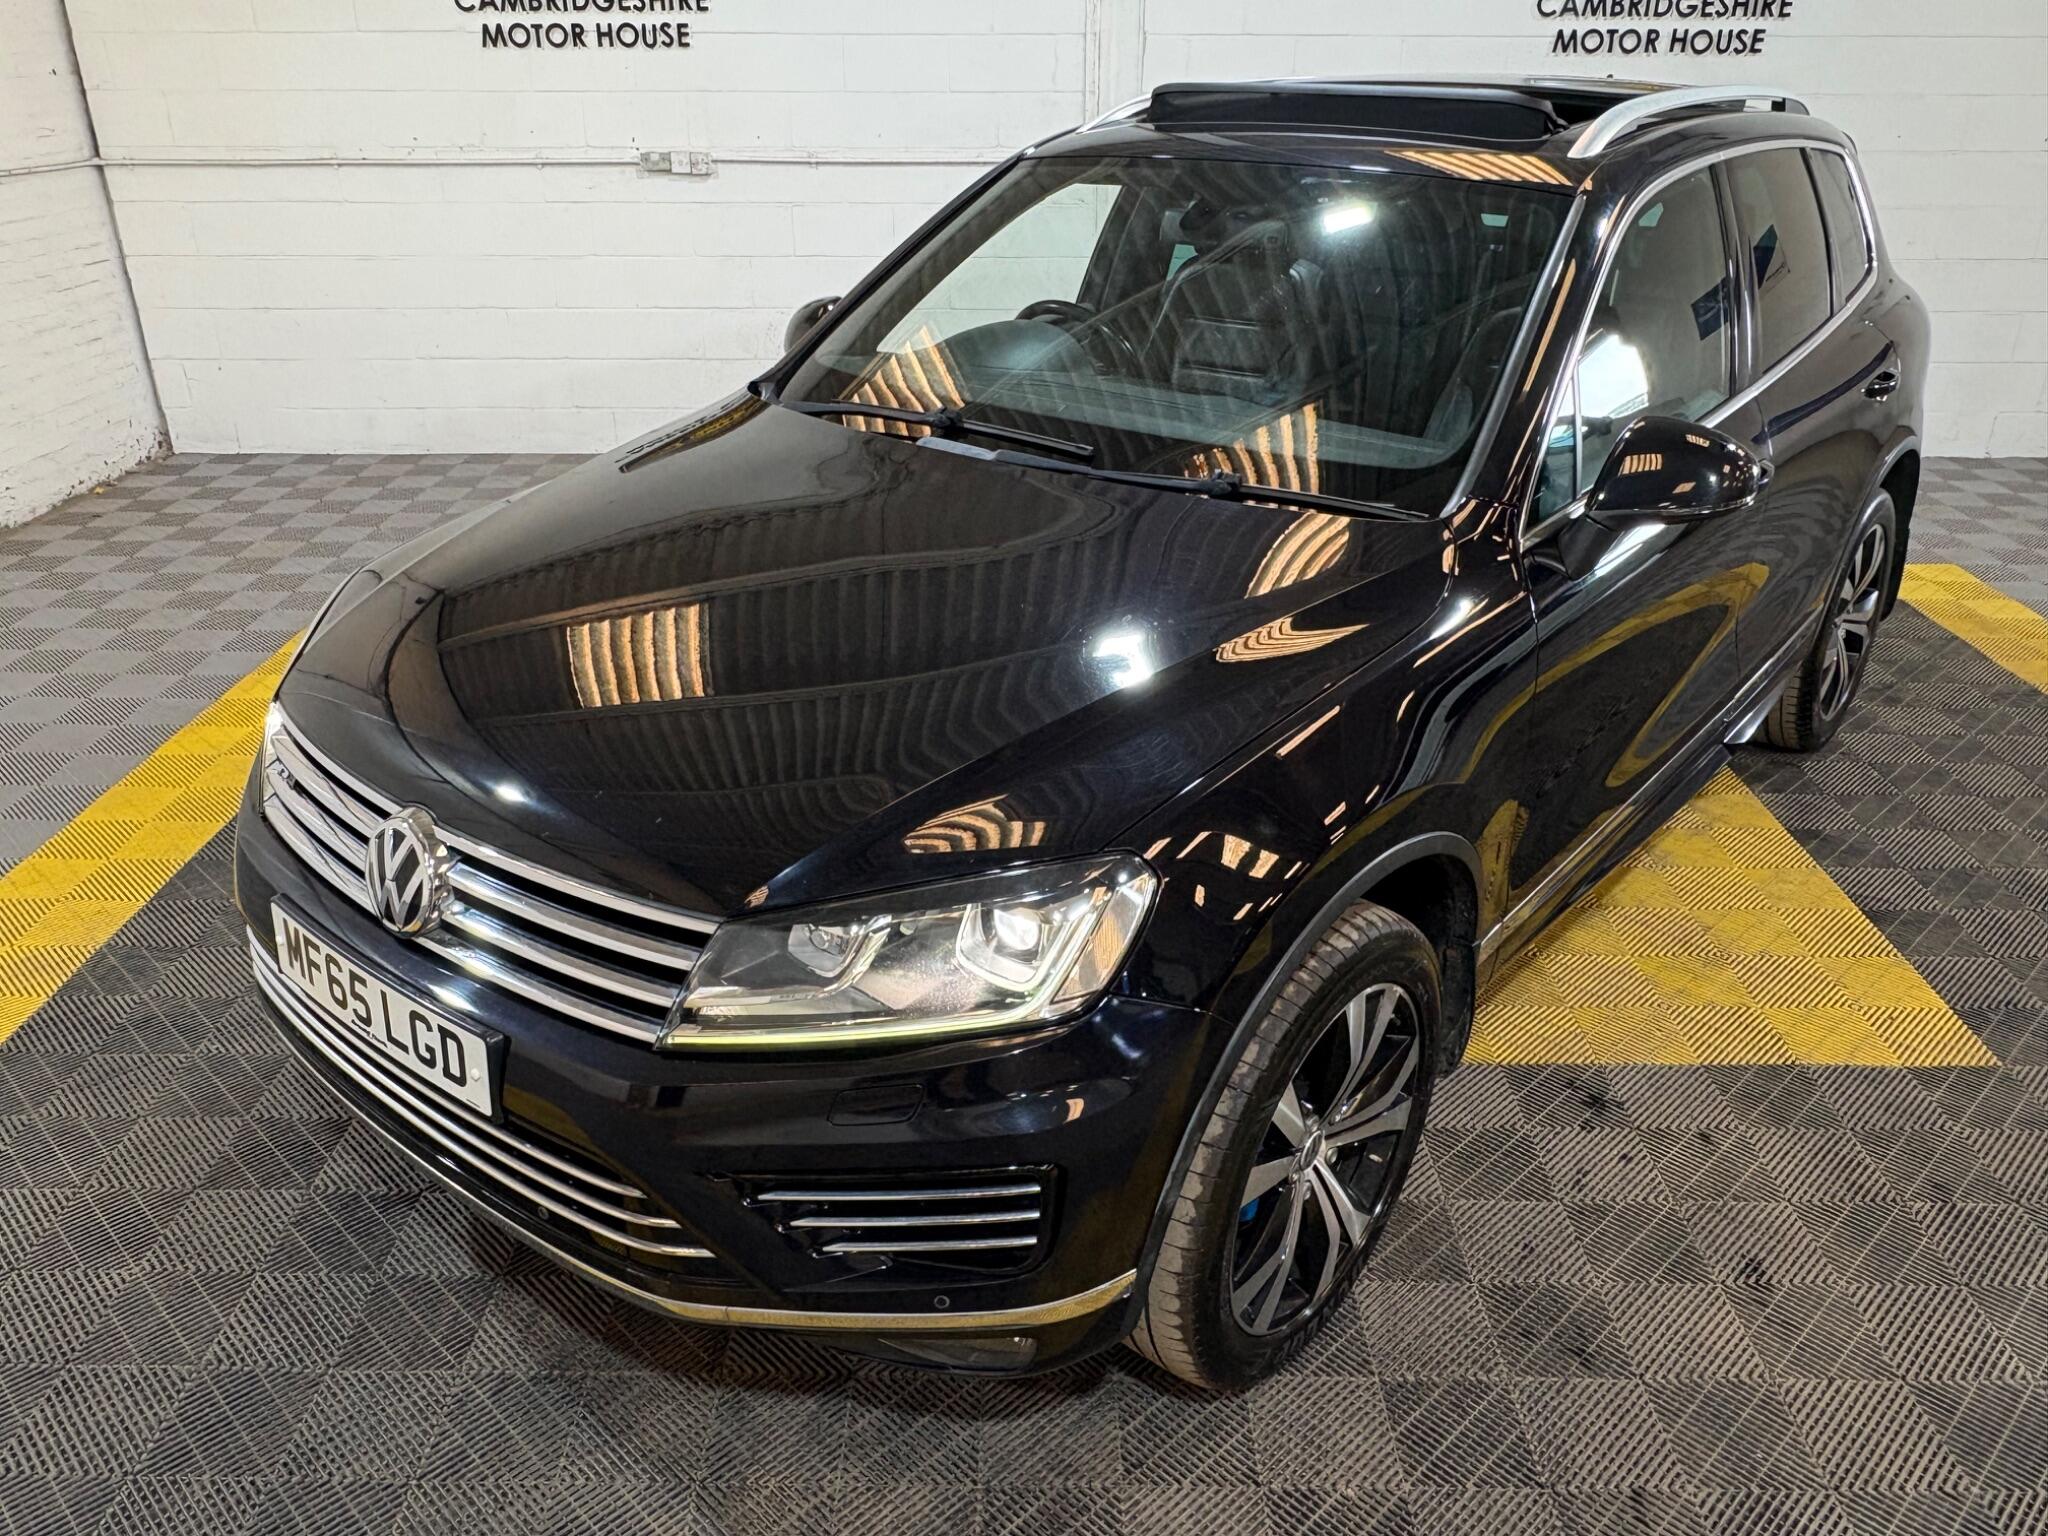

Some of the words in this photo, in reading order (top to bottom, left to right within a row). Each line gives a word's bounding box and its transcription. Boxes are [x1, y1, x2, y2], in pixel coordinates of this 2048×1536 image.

[1537, 0, 1793, 18] CAMBRIDGESHIRE
[482, 23, 587, 48] MOTOR
[596, 22, 690, 49] HOUSE
[1552, 28, 1660, 54] MOTOR
[1669, 28, 1766, 55] HOUSE
[282, 917, 372, 1028] MF65
[381, 989, 467, 1088] LGD
